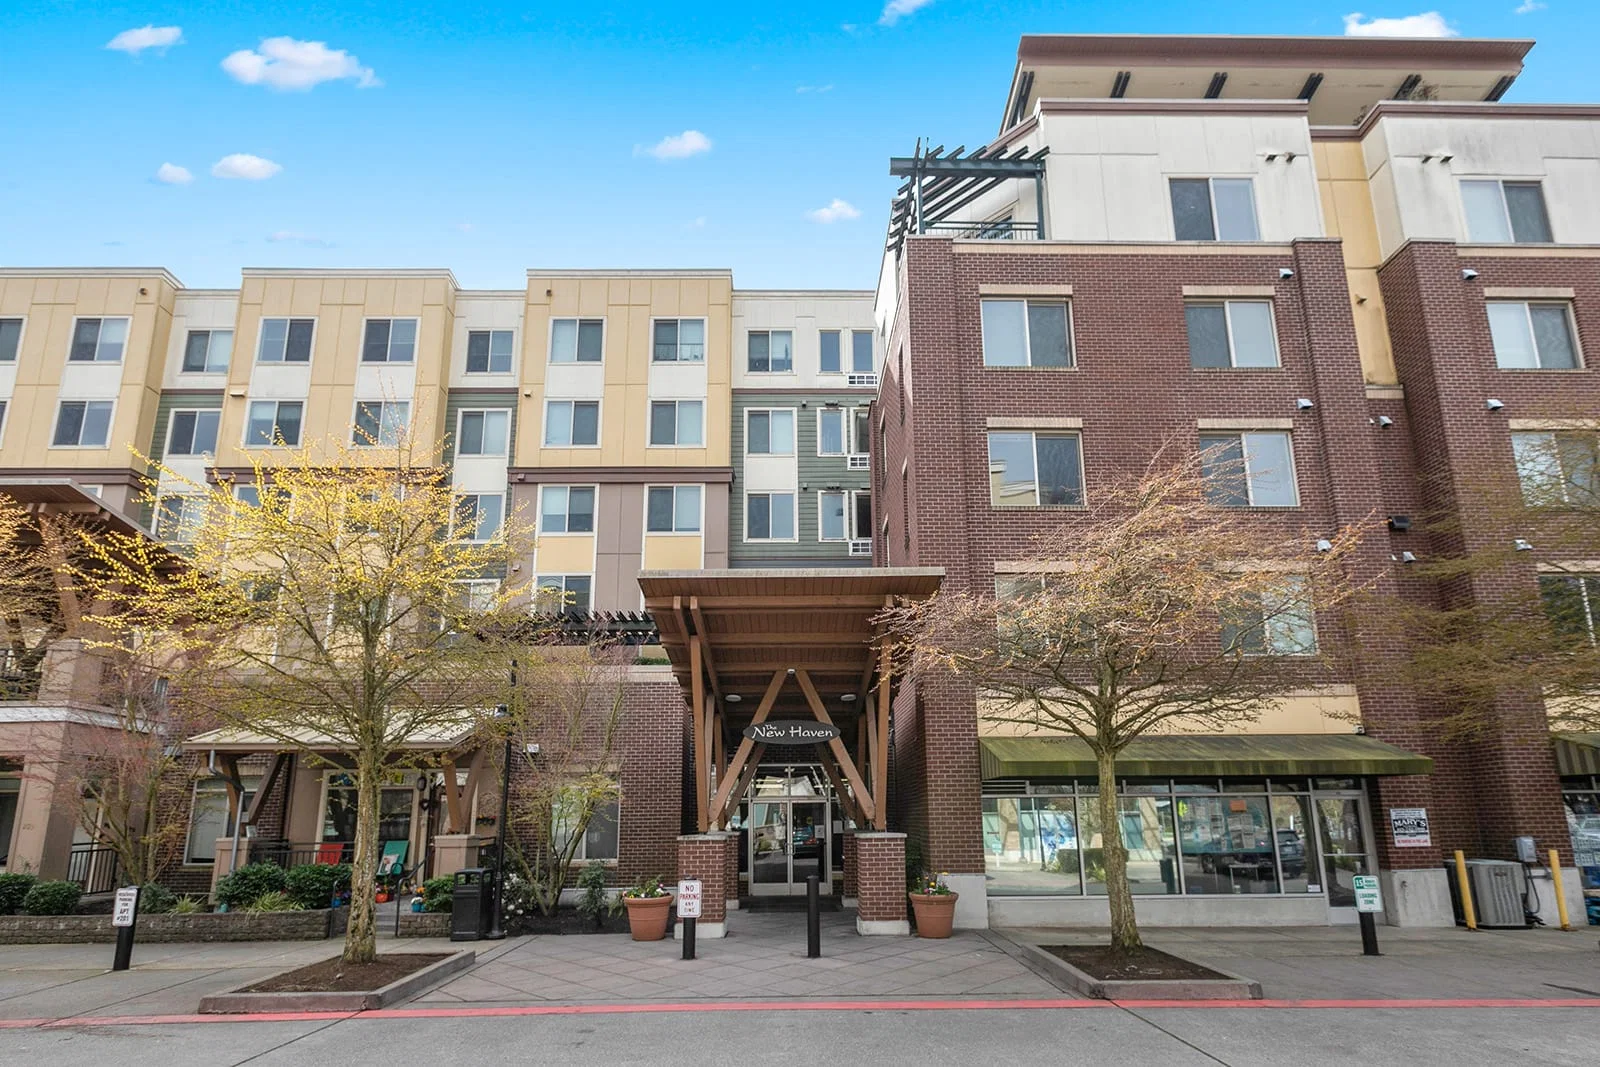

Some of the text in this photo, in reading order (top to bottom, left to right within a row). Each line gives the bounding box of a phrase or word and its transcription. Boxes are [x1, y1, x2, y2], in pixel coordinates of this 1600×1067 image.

[752, 726, 833, 739] New Haven
[1393, 819, 1426, 827] MARY'S
[685, 884, 695, 892] NO
